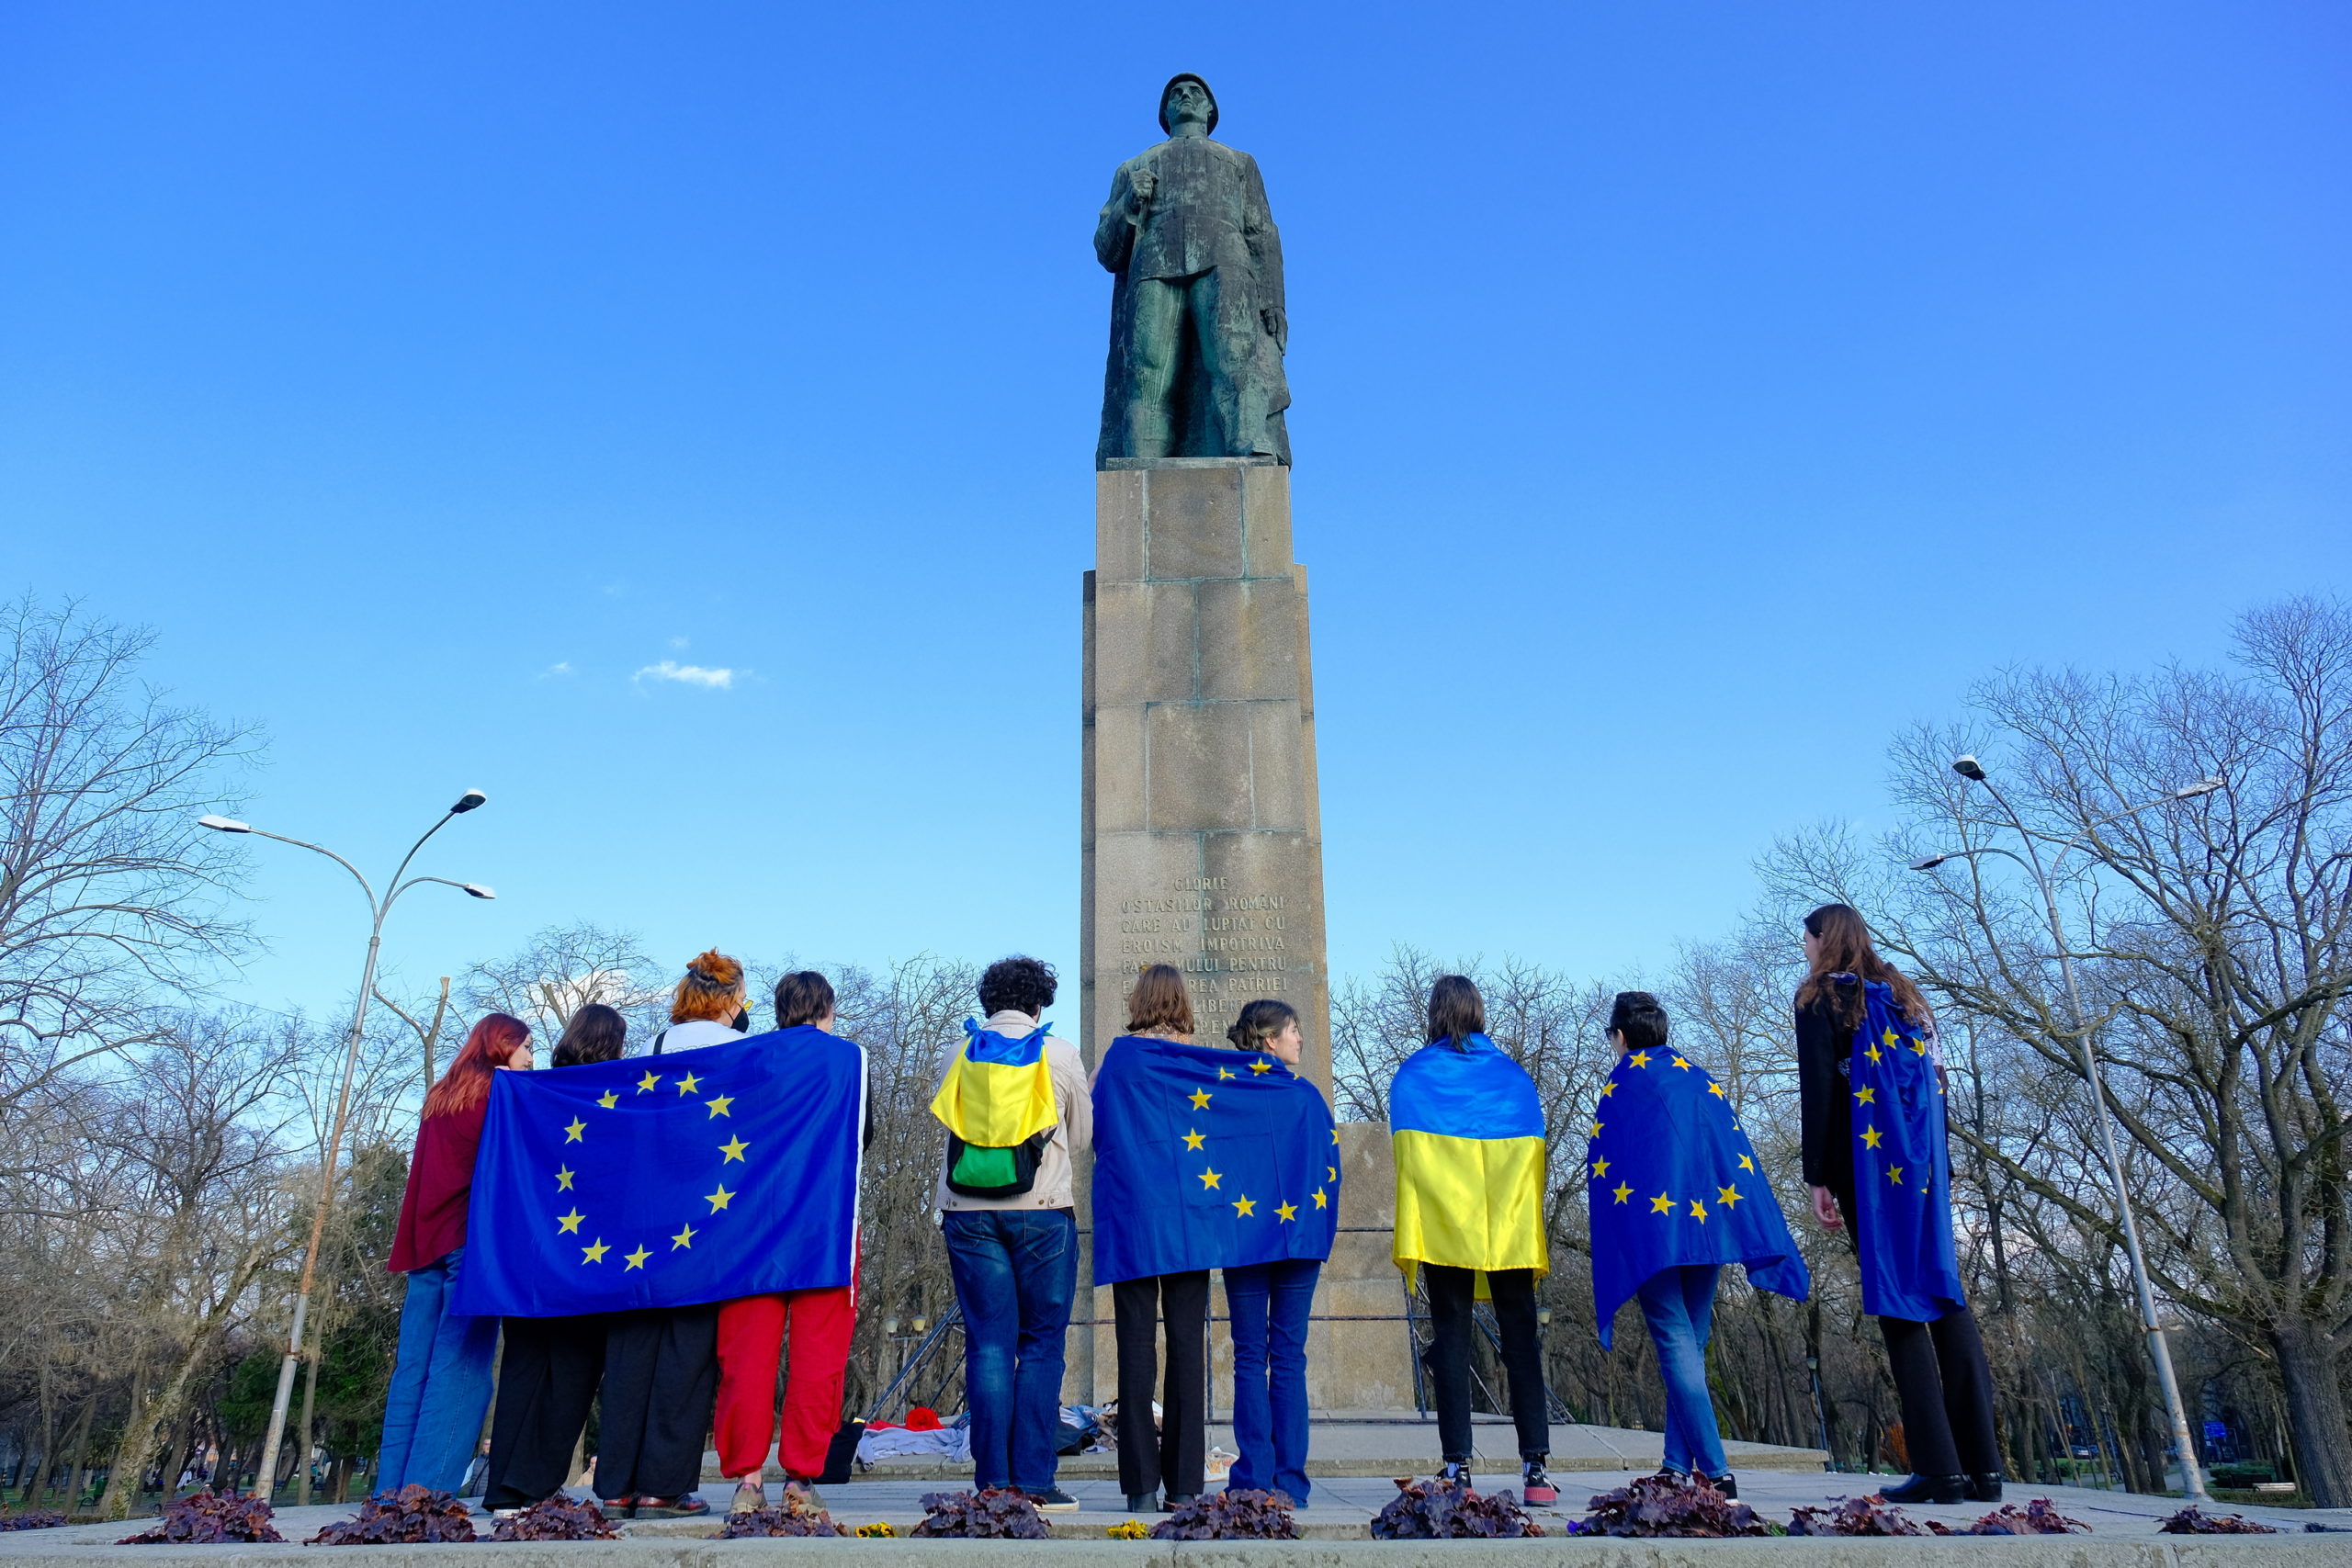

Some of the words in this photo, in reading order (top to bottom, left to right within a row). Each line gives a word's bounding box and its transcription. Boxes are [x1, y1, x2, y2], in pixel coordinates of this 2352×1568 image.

[1174, 876, 1227, 891] GLORIE
[1122, 919, 1161, 933] CARE
[1171, 918, 1191, 932] AU
[1203, 917, 1255, 931] LUPTAT
[1264, 916, 1285, 931] CU
[1122, 938, 1183, 953] EROISM
[1200, 936, 1284, 952] IMPOTRIVA
[1229, 957, 1286, 973] PENTRU
[1228, 976, 1287, 992] PATRIEI
